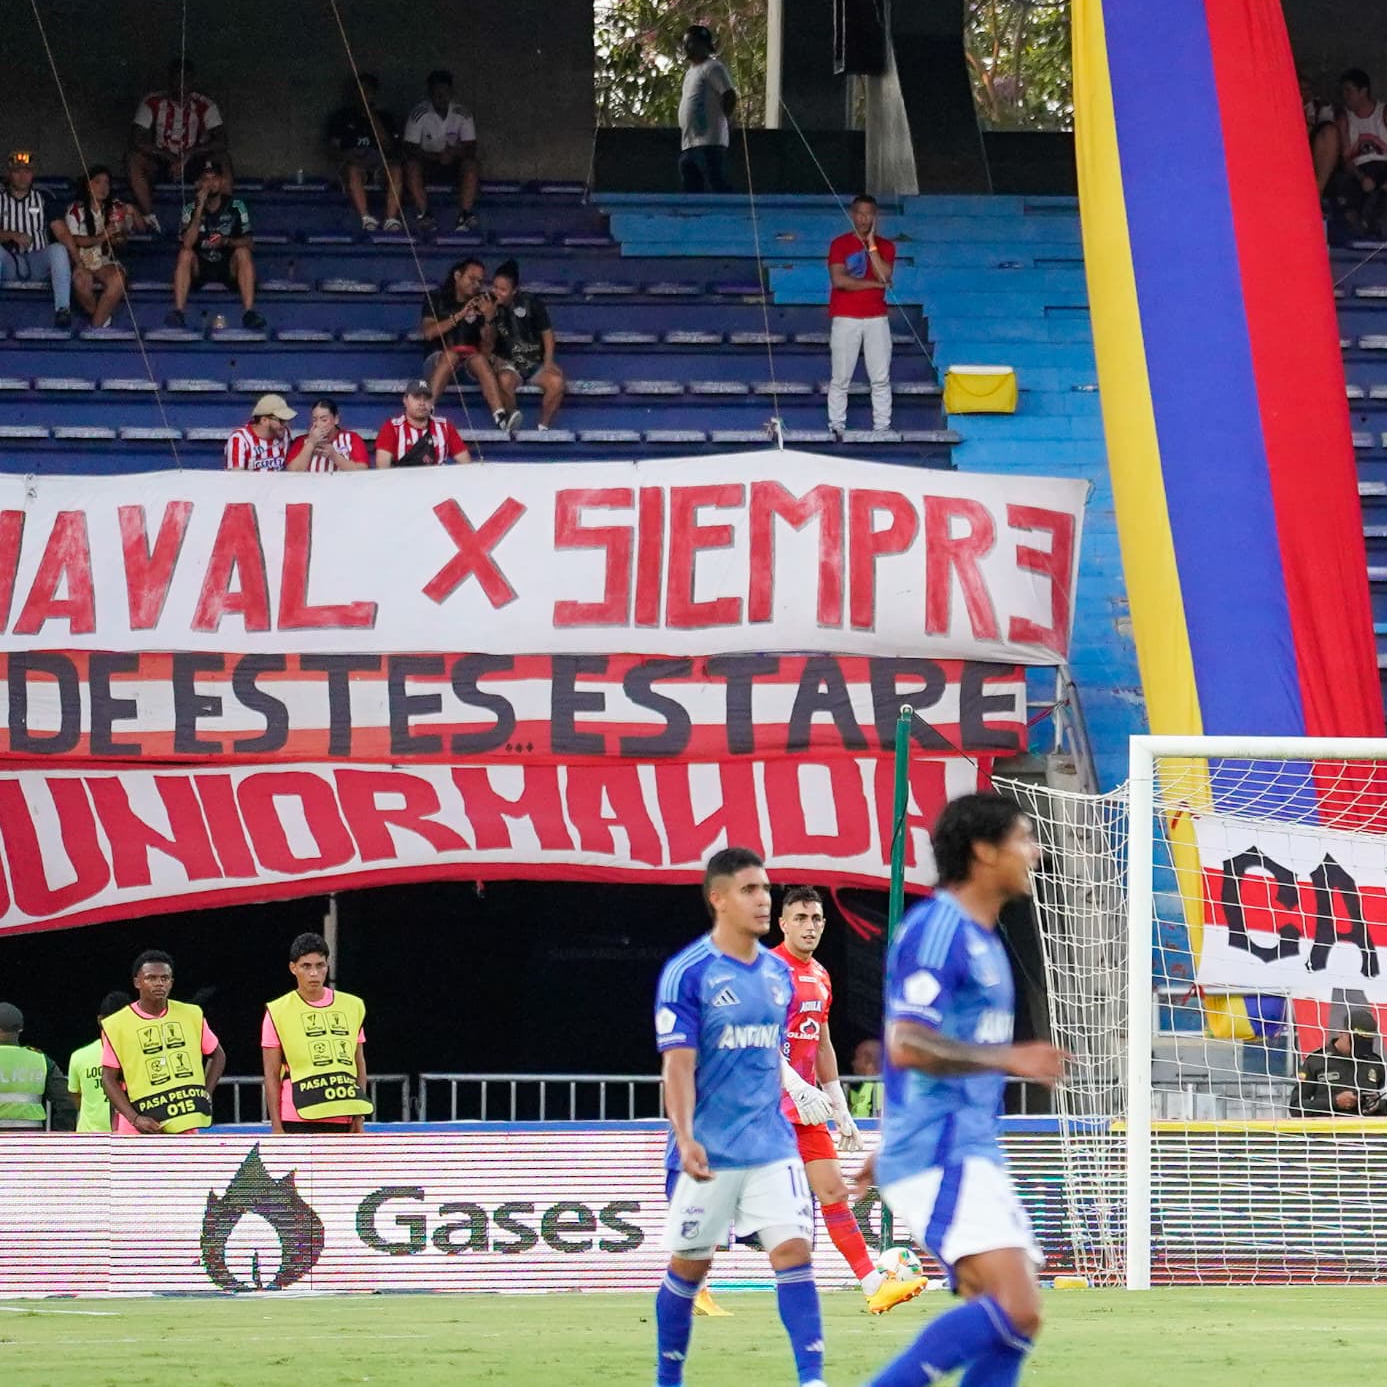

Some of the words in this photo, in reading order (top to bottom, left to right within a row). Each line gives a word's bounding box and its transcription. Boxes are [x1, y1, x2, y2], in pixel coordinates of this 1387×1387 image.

[420, 496, 528, 609] X
[551, 480, 1077, 650] SIEMPRE
[173, 652, 519, 757] ESTES
[551, 654, 1022, 755] ESTARE
[0, 764, 470, 918] UNIOR
[138, 1095, 168, 1112] PASA
[299, 1077, 327, 1092] PASA
[324, 1085, 356, 1100] 006
[166, 1100, 196, 1116] 015
[354, 1185, 646, 1257] Gases
